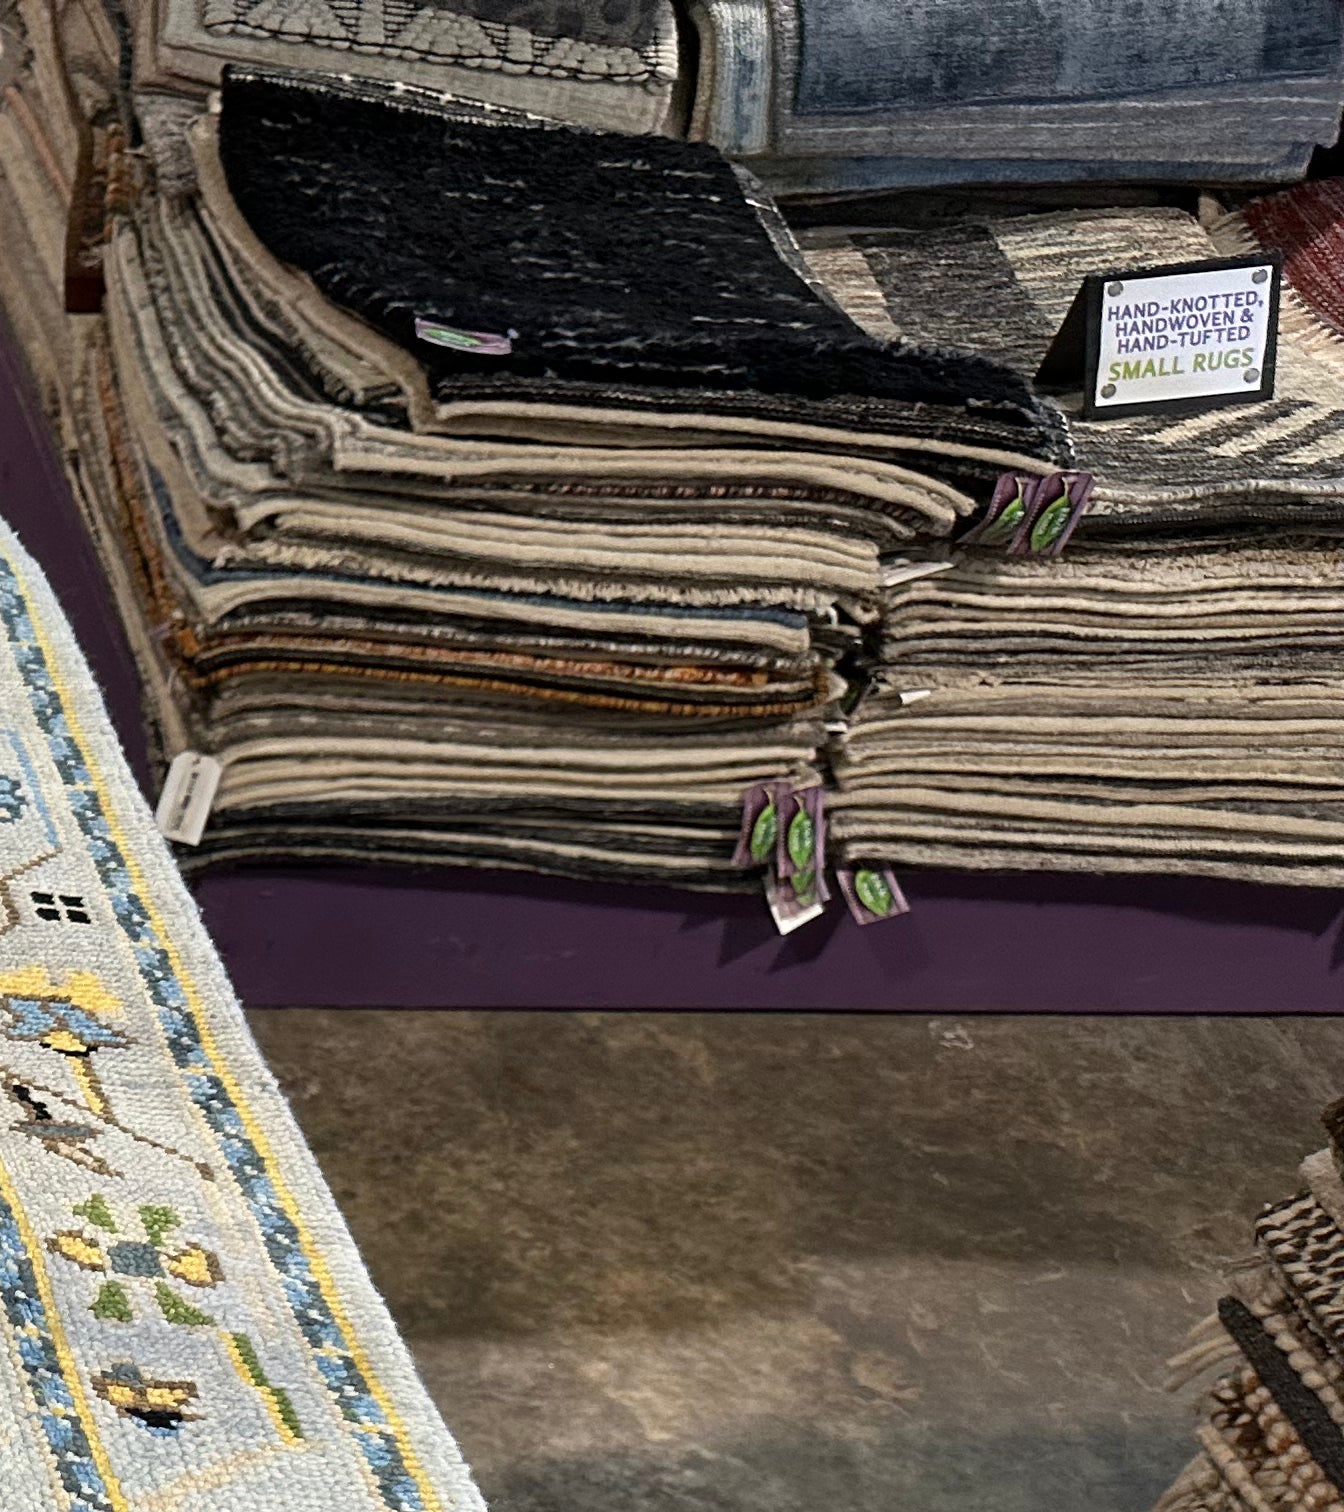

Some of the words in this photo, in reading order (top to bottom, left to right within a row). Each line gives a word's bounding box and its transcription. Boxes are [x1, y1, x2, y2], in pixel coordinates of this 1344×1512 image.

[1108, 291, 1263, 321] HAND-KNOTTED,
[1115, 311, 1235, 337] HANDWOVEN
[1239, 308, 1254, 323] &
[1117, 326, 1250, 354] HAND-TUFTED
[1108, 356, 1184, 381] SMALL
[1192, 348, 1254, 373] RUGS
